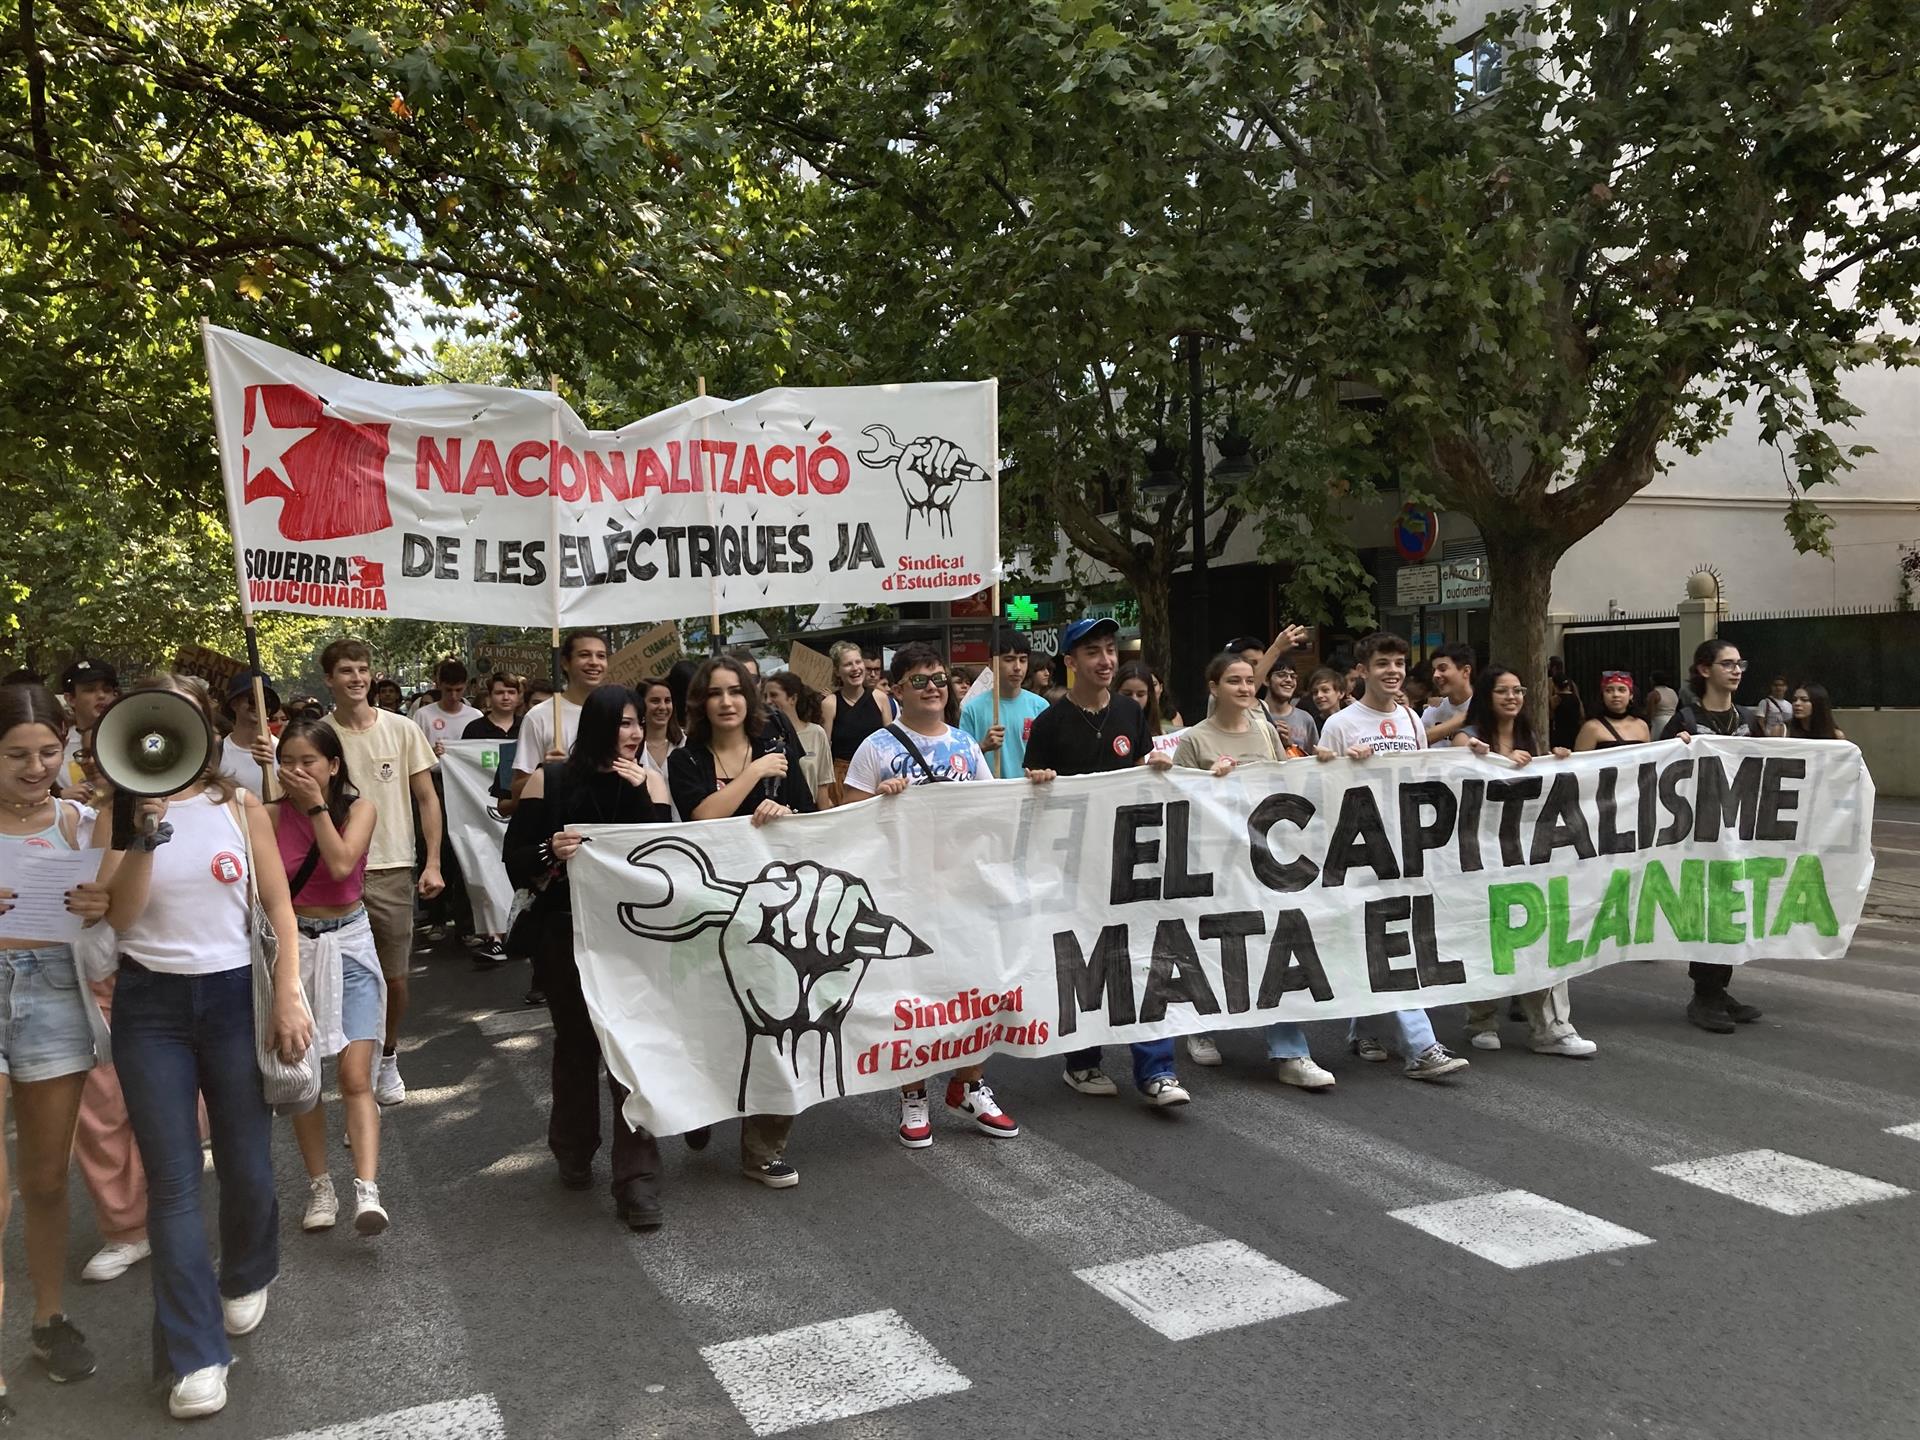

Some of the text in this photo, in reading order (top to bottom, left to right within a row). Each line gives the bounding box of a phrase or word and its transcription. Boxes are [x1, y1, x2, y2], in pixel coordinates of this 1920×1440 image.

[416, 430, 850, 502] NACIONALITZACIÓ
[244, 548, 349, 585] SQUERRA
[402, 517, 885, 588] DE LES ELÈCTRIQUES JA
[898, 555, 964, 571] Sindicat
[248, 580, 387, 610] VOLUCIONÀRIA
[1110, 800, 1214, 905] EL
[1247, 756, 1806, 893] CAPITALISME
[1053, 854, 1839, 1037] MATA EL PLANETA
[893, 985, 1023, 1032] Sindicat
[856, 1019, 1049, 1075] d'Estudiants
